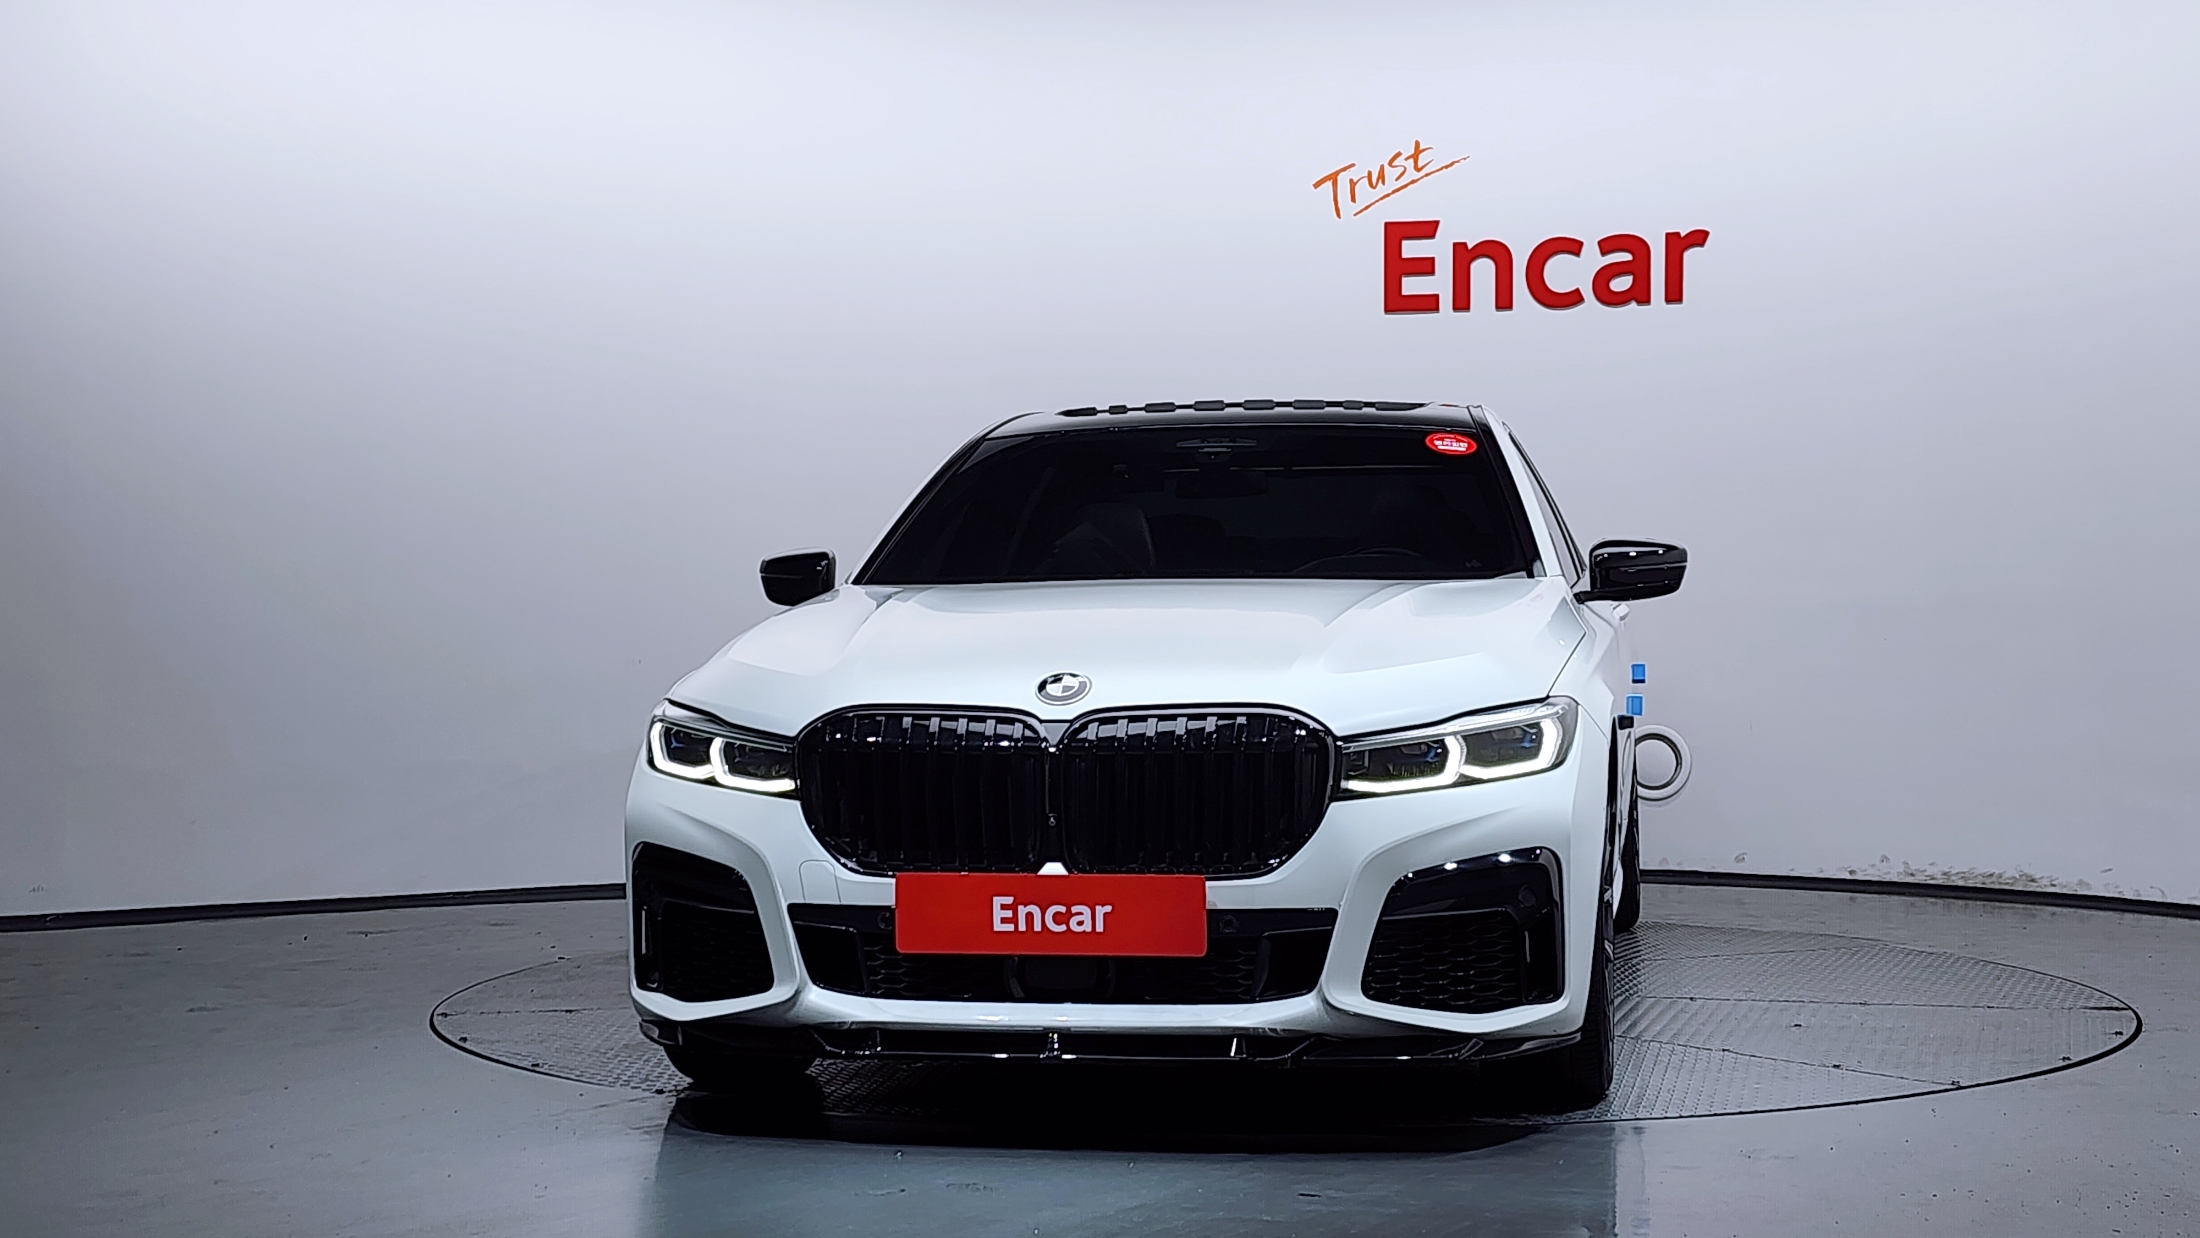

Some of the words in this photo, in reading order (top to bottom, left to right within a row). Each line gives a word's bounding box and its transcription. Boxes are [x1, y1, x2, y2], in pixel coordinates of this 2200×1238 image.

[1312, 140, 1434, 219] Trust
[1384, 220, 1710, 315] Encar
[992, 896, 1113, 933] Encar
